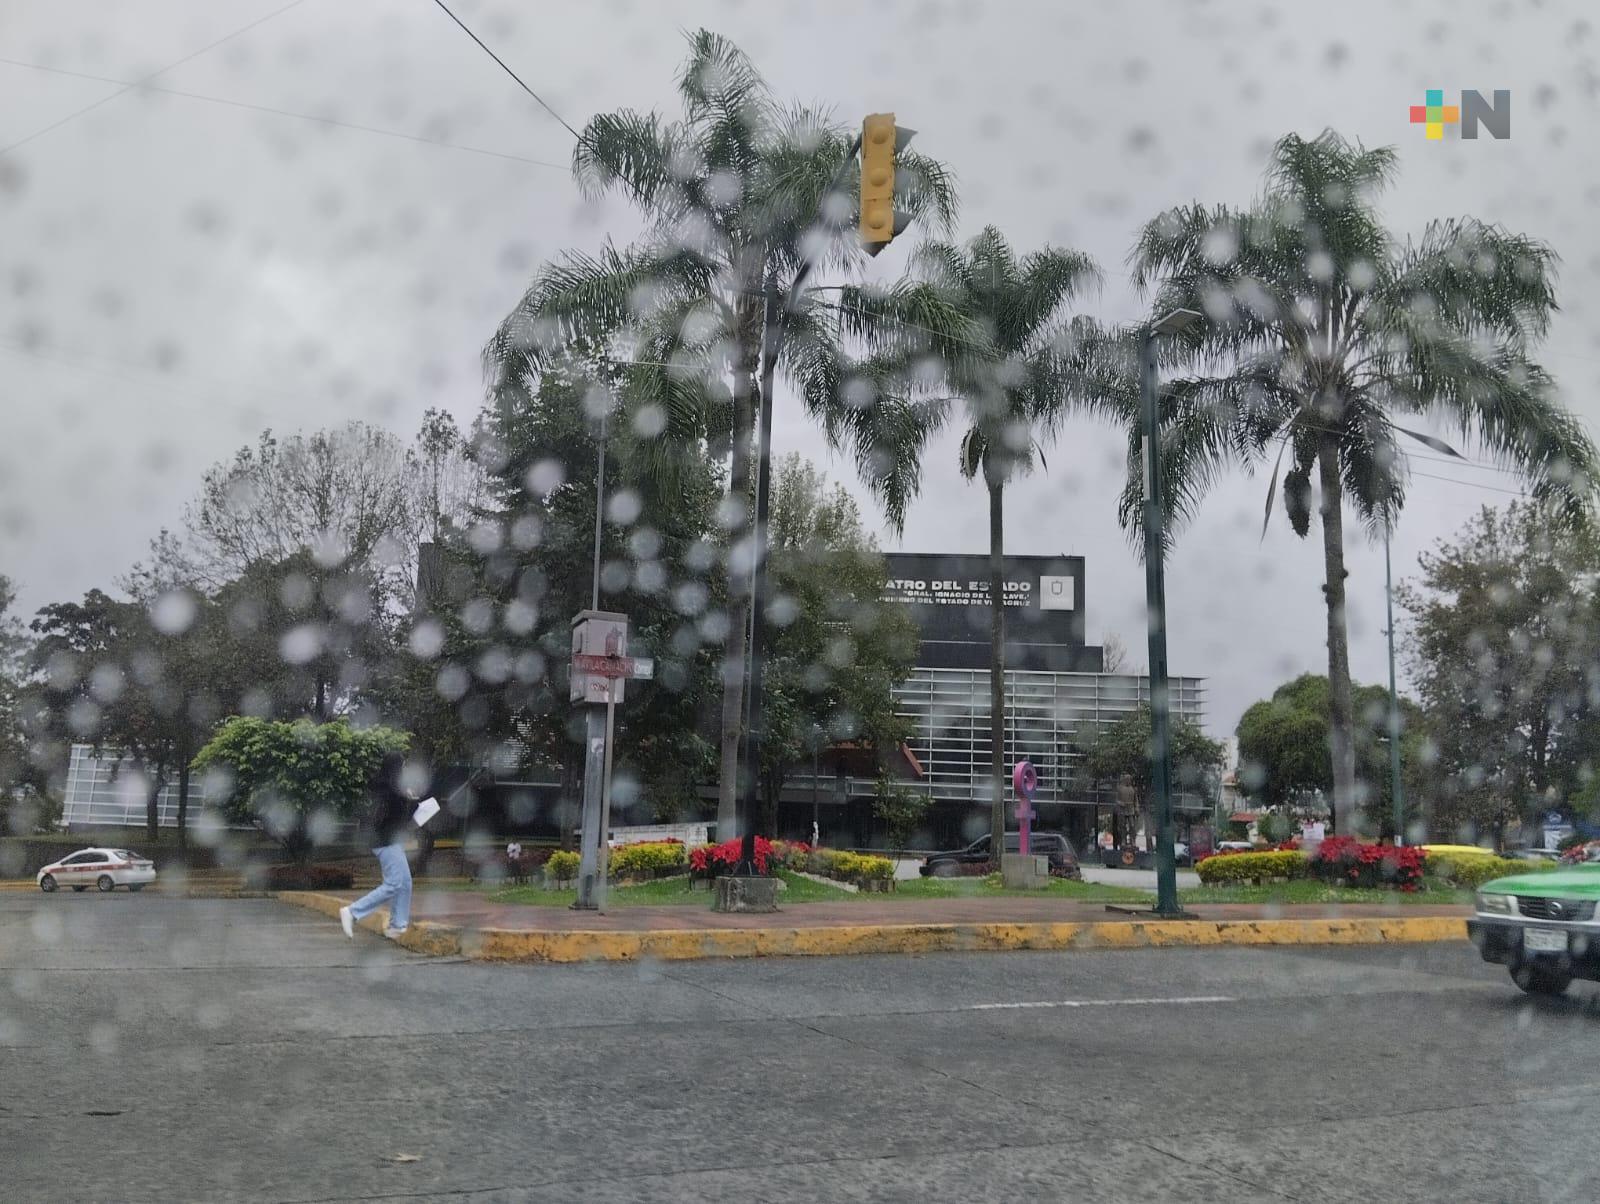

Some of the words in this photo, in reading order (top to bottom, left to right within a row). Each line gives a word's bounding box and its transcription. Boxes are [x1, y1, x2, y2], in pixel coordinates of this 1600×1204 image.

[876, 579, 927, 591] ATRO
[931, 580, 962, 591] DEL
[968, 581, 1031, 592] ESADO
[984, 599, 1031, 607] VACRUZ
